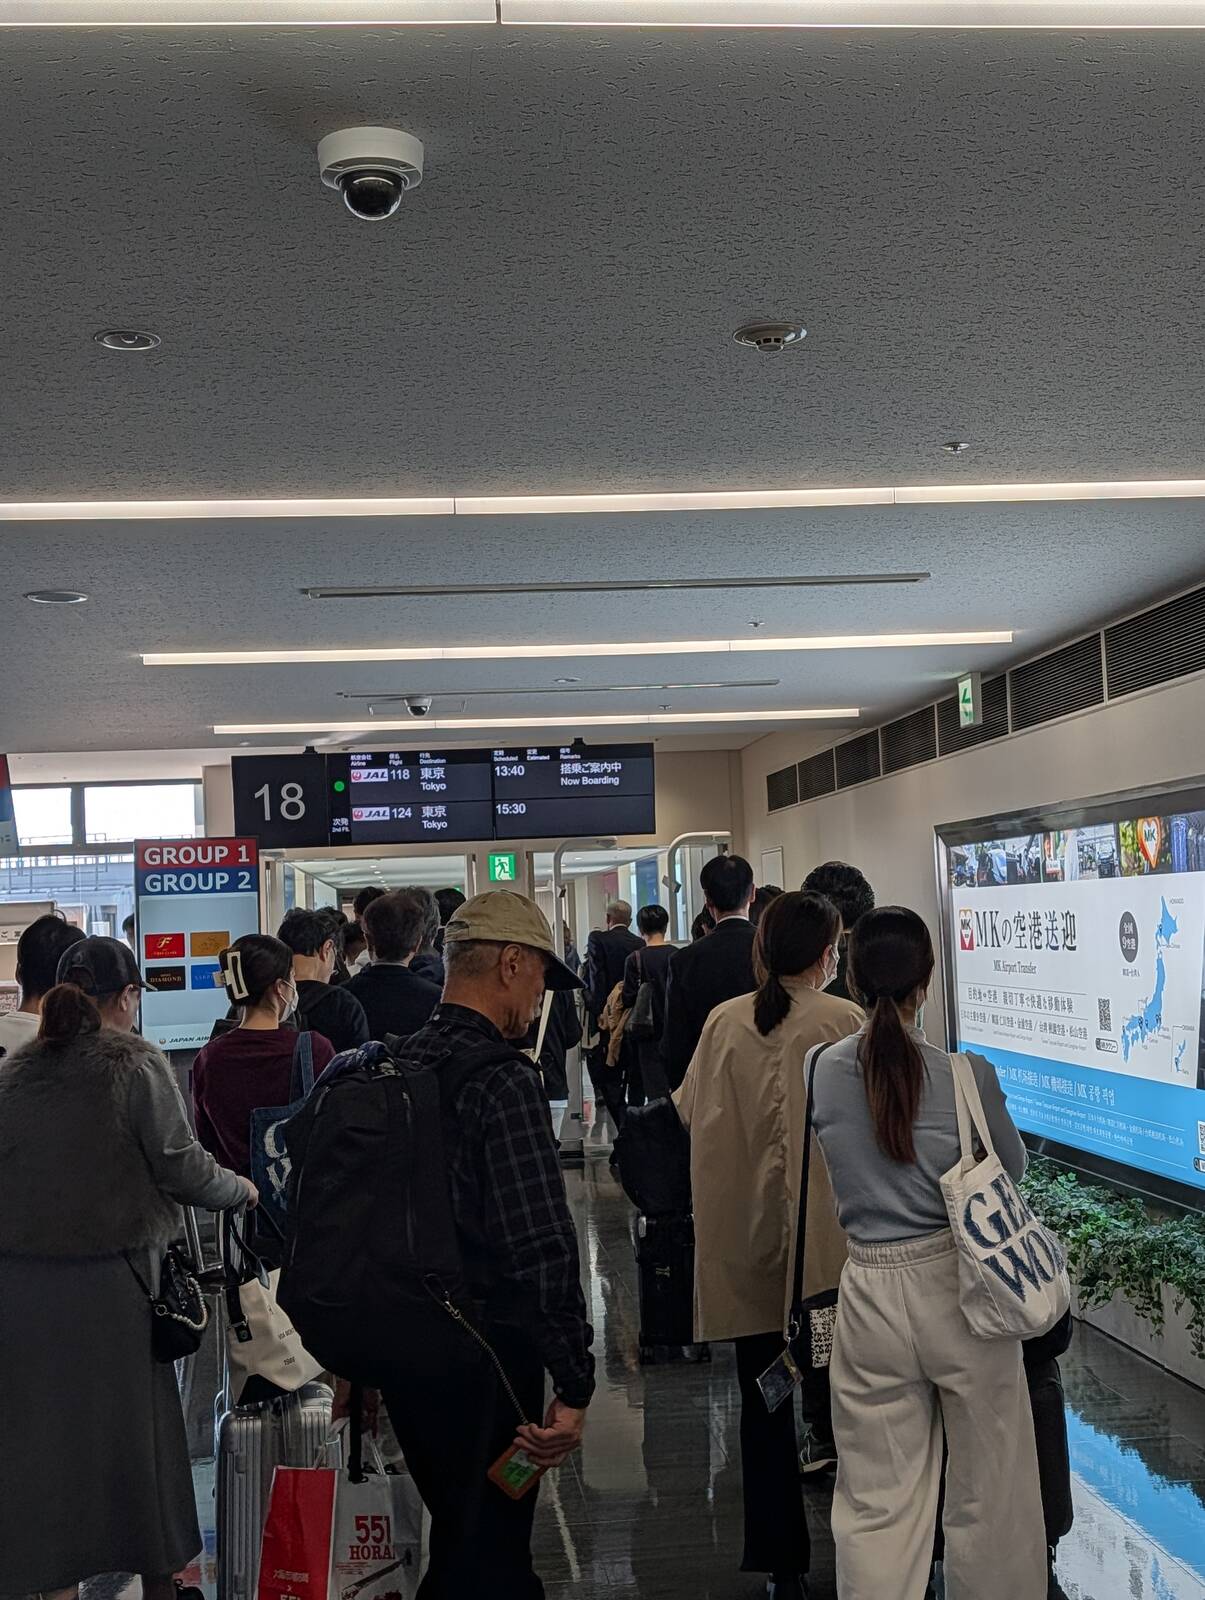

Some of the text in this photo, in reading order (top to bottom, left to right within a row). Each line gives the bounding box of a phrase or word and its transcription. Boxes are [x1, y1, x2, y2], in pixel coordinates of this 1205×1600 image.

[363, 769, 410, 780] JAL 118
[420, 767, 445, 780] 東京
[494, 765, 525, 776] 13:40
[560, 762, 622, 774] 搭乗ご案内中
[420, 782, 447, 792] Tokyo
[560, 776, 620, 786] Now Boarding
[254, 782, 306, 821] 18
[364, 807, 412, 818] JAL 124
[421, 805, 447, 818] 東京
[496, 803, 526, 814] 15:30
[332, 818, 349, 826] 次発
[422, 820, 448, 830] Tokyo
[1144, 828, 1157, 842] MK
[144, 845, 250, 865] GROUP 1
[144, 871, 252, 892] GROUP 2
[961, 918, 972, 931] MK
[975, 910, 1077, 951] MKの空港送迎
[993, 960, 1037, 975] MK Airport Transfer
[963, 1173, 1033, 1249] GE
[355, 1515, 391, 1544] 551
[349, 1545, 396, 1560] HORA
